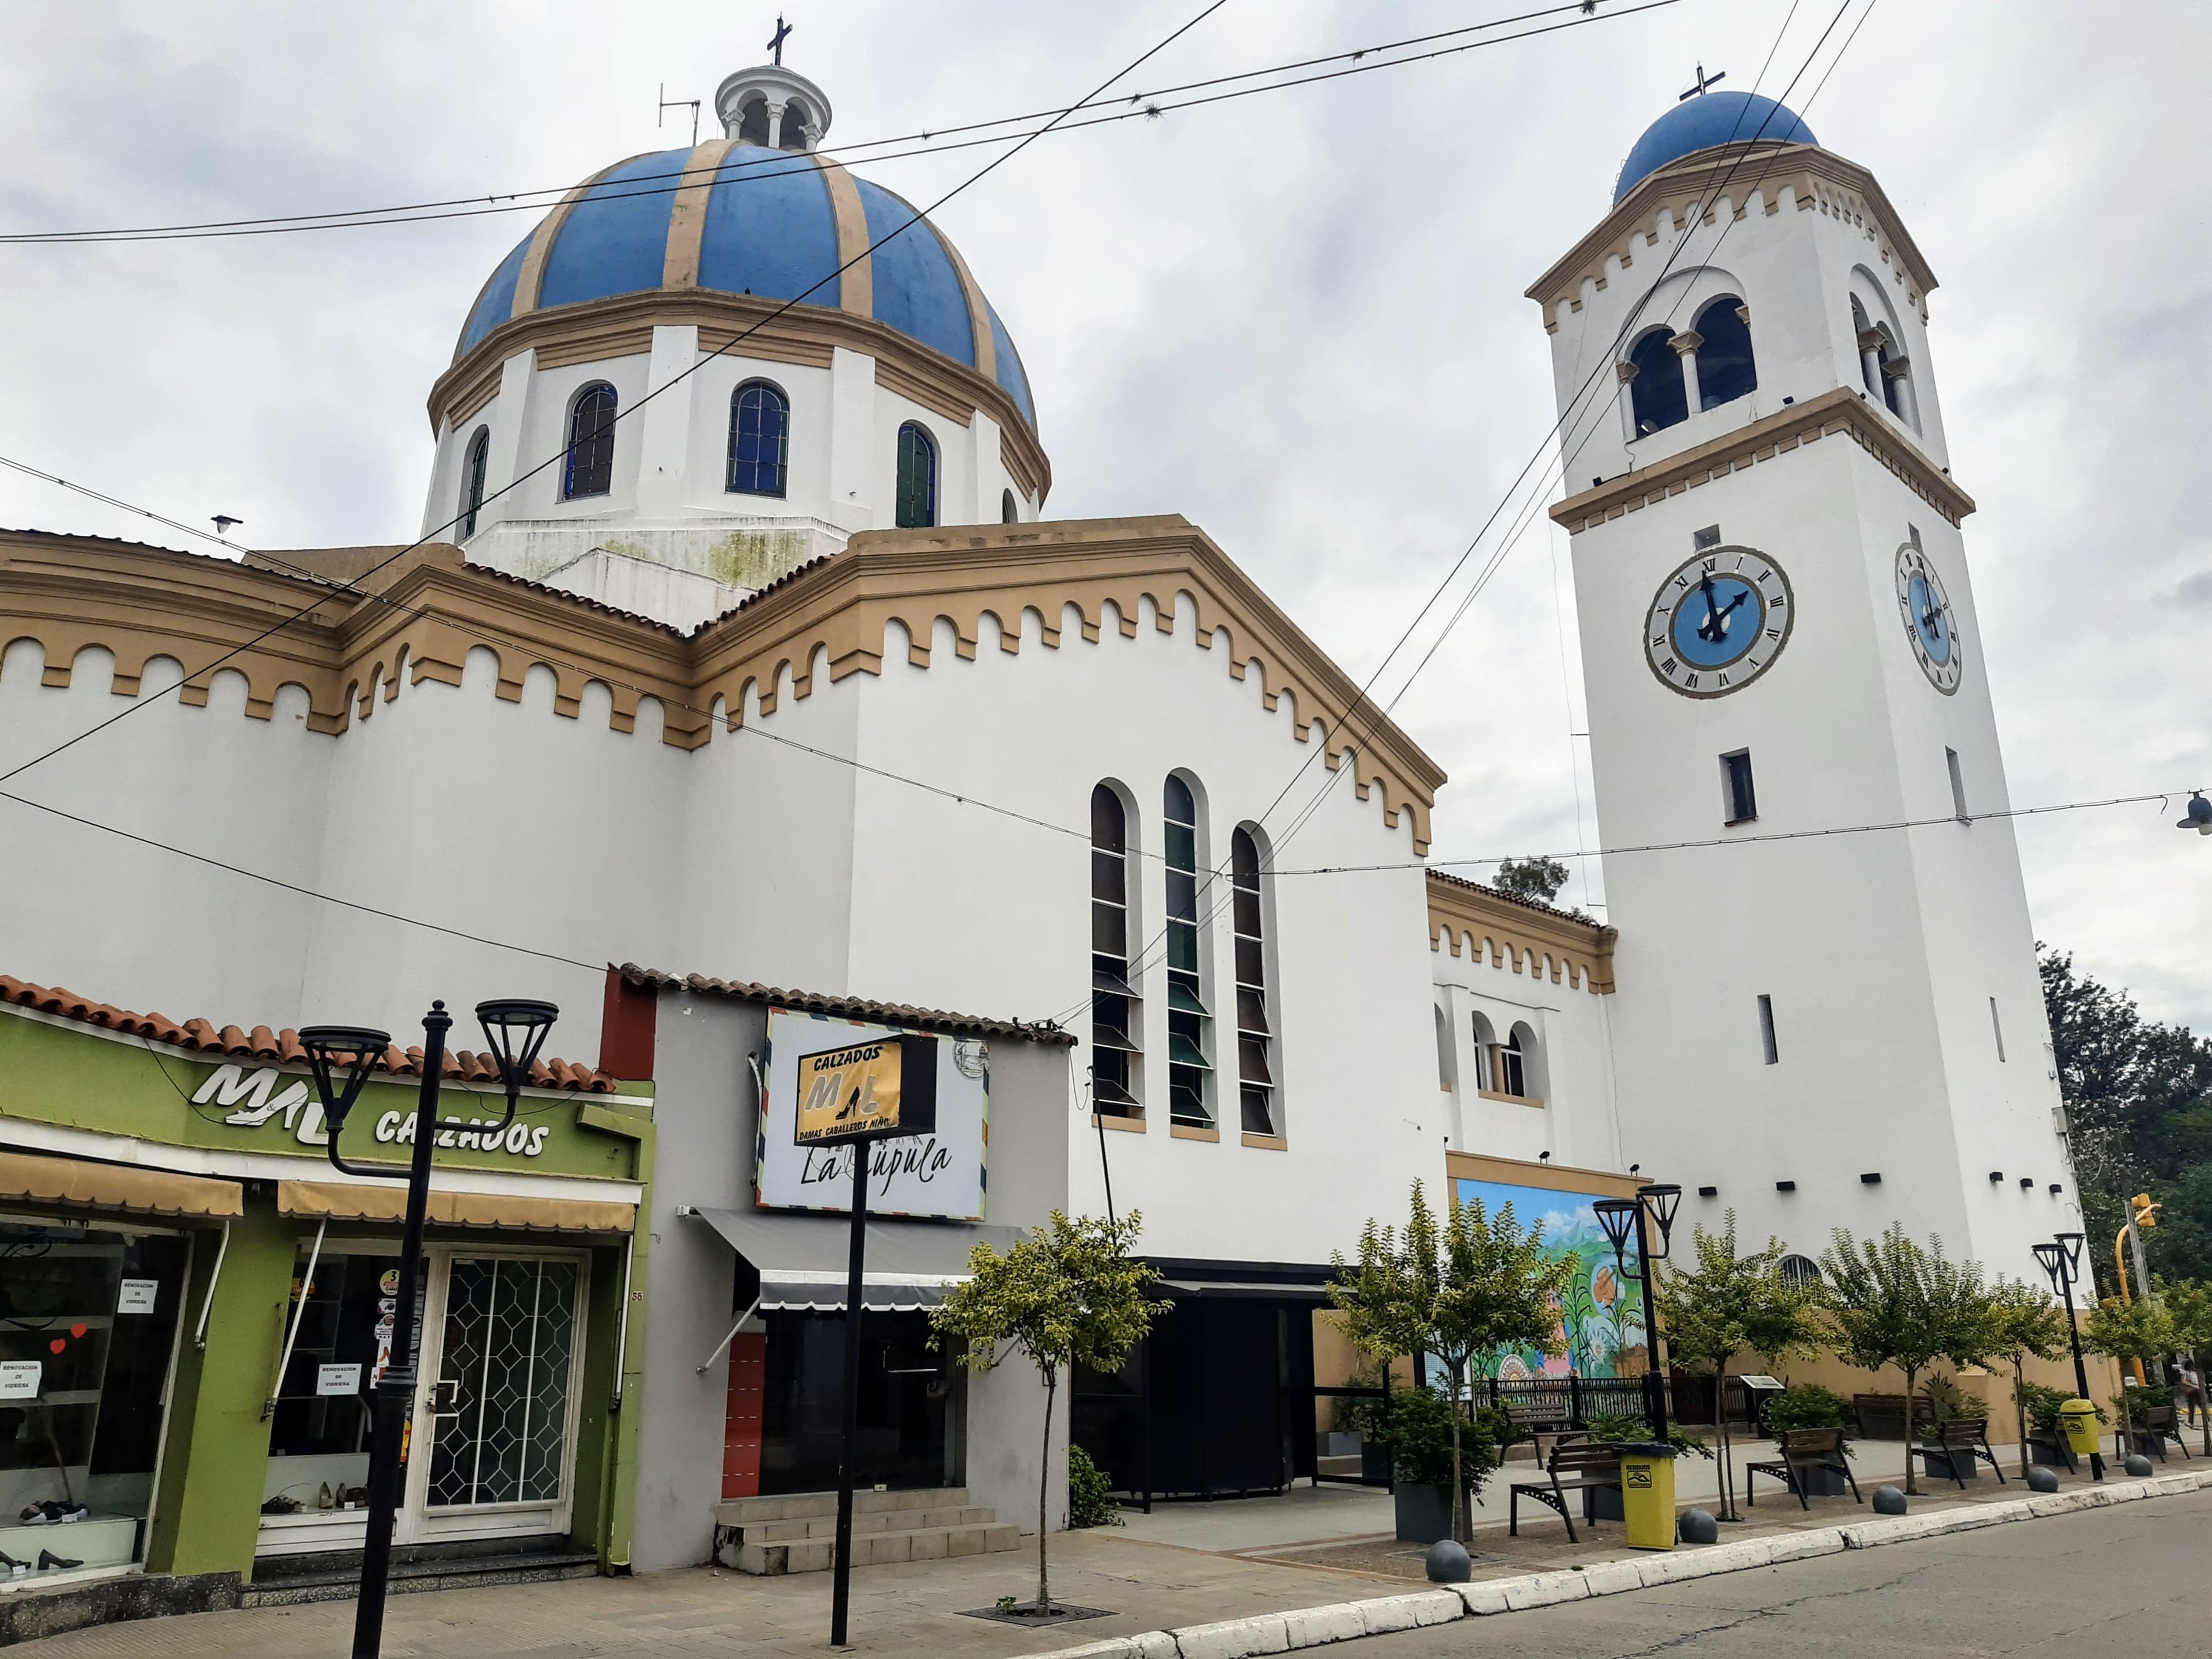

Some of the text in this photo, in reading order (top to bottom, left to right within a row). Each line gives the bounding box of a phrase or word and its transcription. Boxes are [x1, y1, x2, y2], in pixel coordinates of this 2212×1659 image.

[1703, 558, 1715, 573] XII
[1675, 575, 1689, 590] XI
[1758, 570, 1771, 583] II
[1770, 596, 1784, 608] III
[1657, 606, 1671, 615] X
[1653, 634, 1665, 647] IX
[1766, 628, 1781, 641] IV
[1661, 657, 1677, 675] VIII
[1748, 658, 1759, 669] V
[1685, 673, 1699, 688] VII
[1719, 672, 1730, 687] VI
[814, 1046, 883, 1071] CALZADOS
[376, 1111, 550, 1156] CAZADOS
[799, 1129, 822, 1140] DAMAS
[825, 1120, 868, 1137] CABALLEROS
[801, 1146, 842, 1184] La
